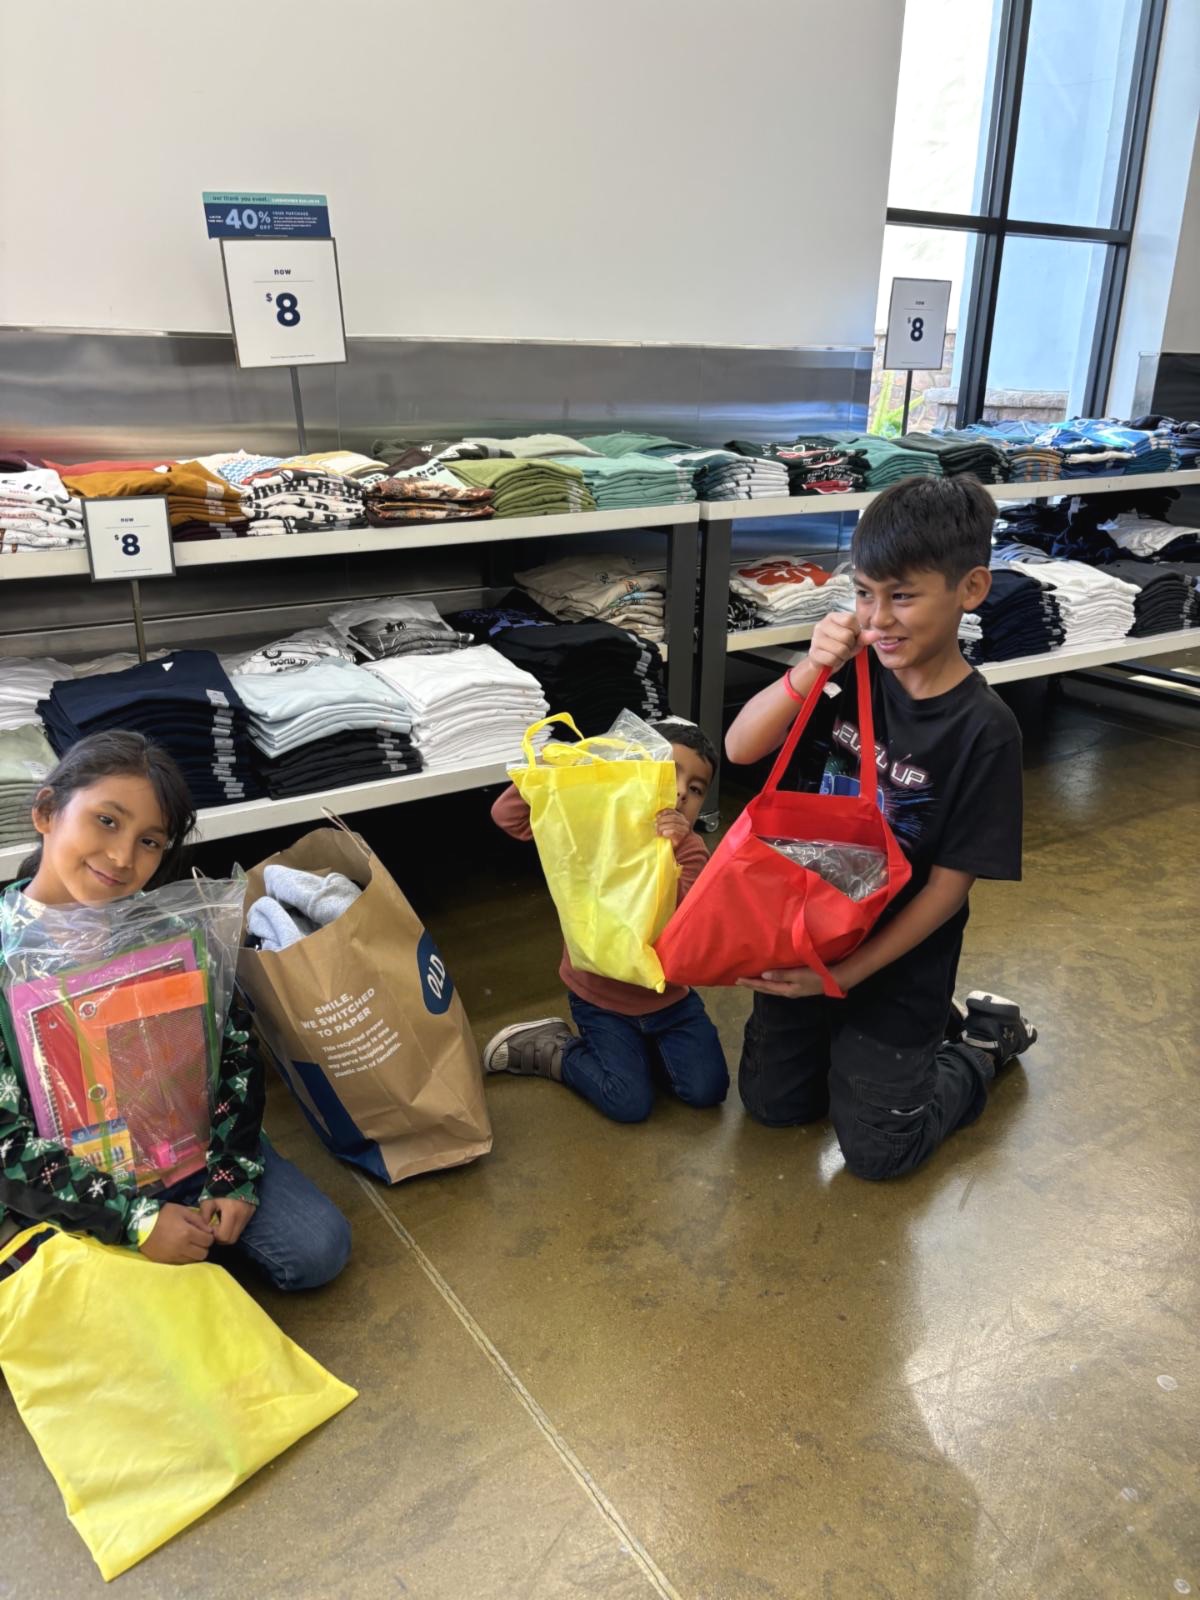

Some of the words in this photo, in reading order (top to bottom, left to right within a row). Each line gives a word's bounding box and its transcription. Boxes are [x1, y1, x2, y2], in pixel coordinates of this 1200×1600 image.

[265, 292, 301, 328] $8
[114, 533, 140, 556] $8
[891, 762, 926, 785] UP
[427, 953, 446, 1000] OLD
[301, 1020, 319, 1029] WE
[319, 988, 375, 1026] SWITCHED
[314, 993, 354, 1015] SMILE,
[317, 1028, 333, 1038] TO
[335, 1007, 372, 1033] PAPER
[337, 1033, 365, 1048] recycled
